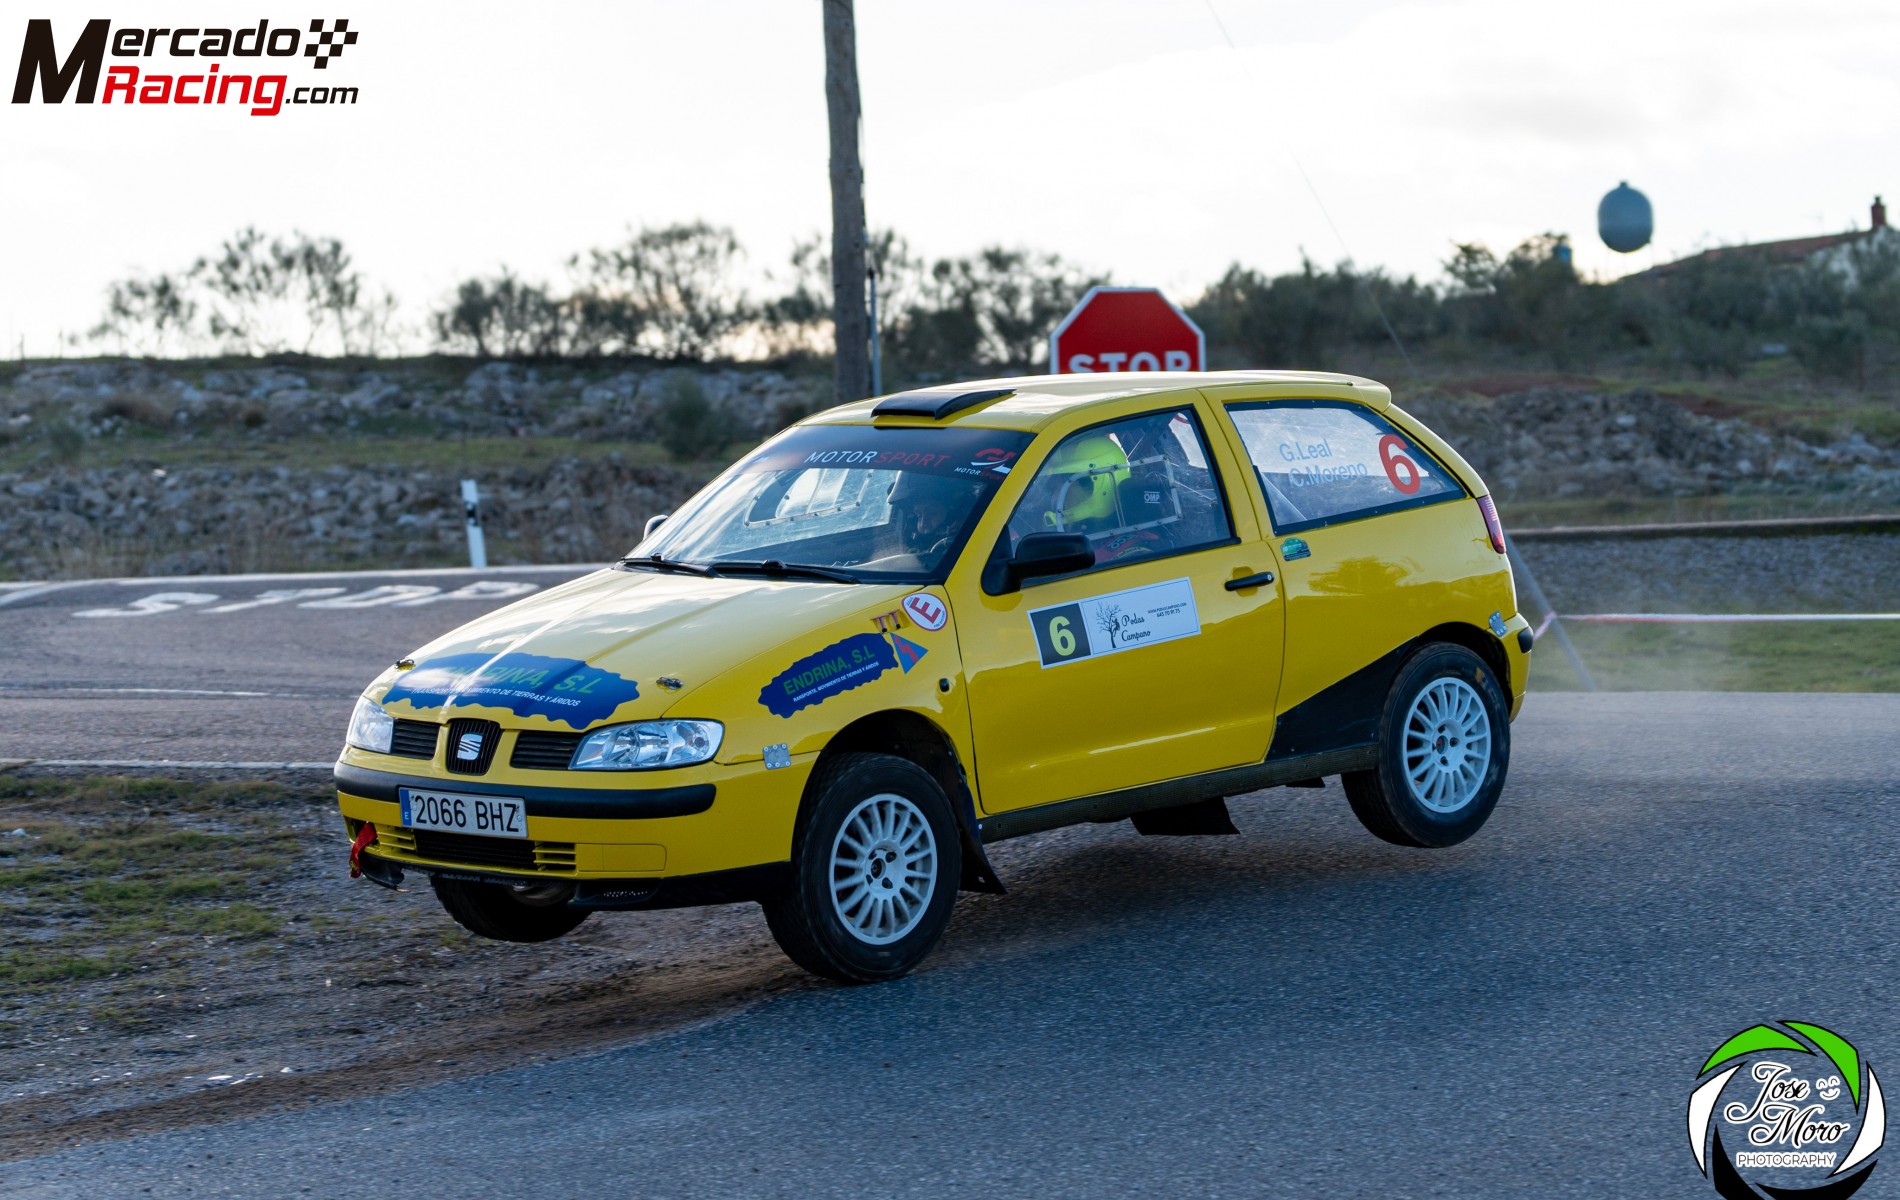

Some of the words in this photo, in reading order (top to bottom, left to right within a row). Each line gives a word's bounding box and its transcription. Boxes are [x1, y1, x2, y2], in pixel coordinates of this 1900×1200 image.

[1279, 438, 1333, 462] G.Leal
[1288, 462, 1368, 487] C.Moreno
[1378, 433, 1421, 495] 6
[1144, 492, 1160, 502] OMP
[909, 597, 941, 624] E
[1121, 614, 1145, 627] Podas
[1049, 615, 1076, 656] 6
[1121, 629, 1151, 642] Campano
[512, 690, 545, 702] TIERRAS
[404, 811, 409, 820] E
[415, 795, 467, 828] 2066
[475, 800, 519, 832] BHZ
